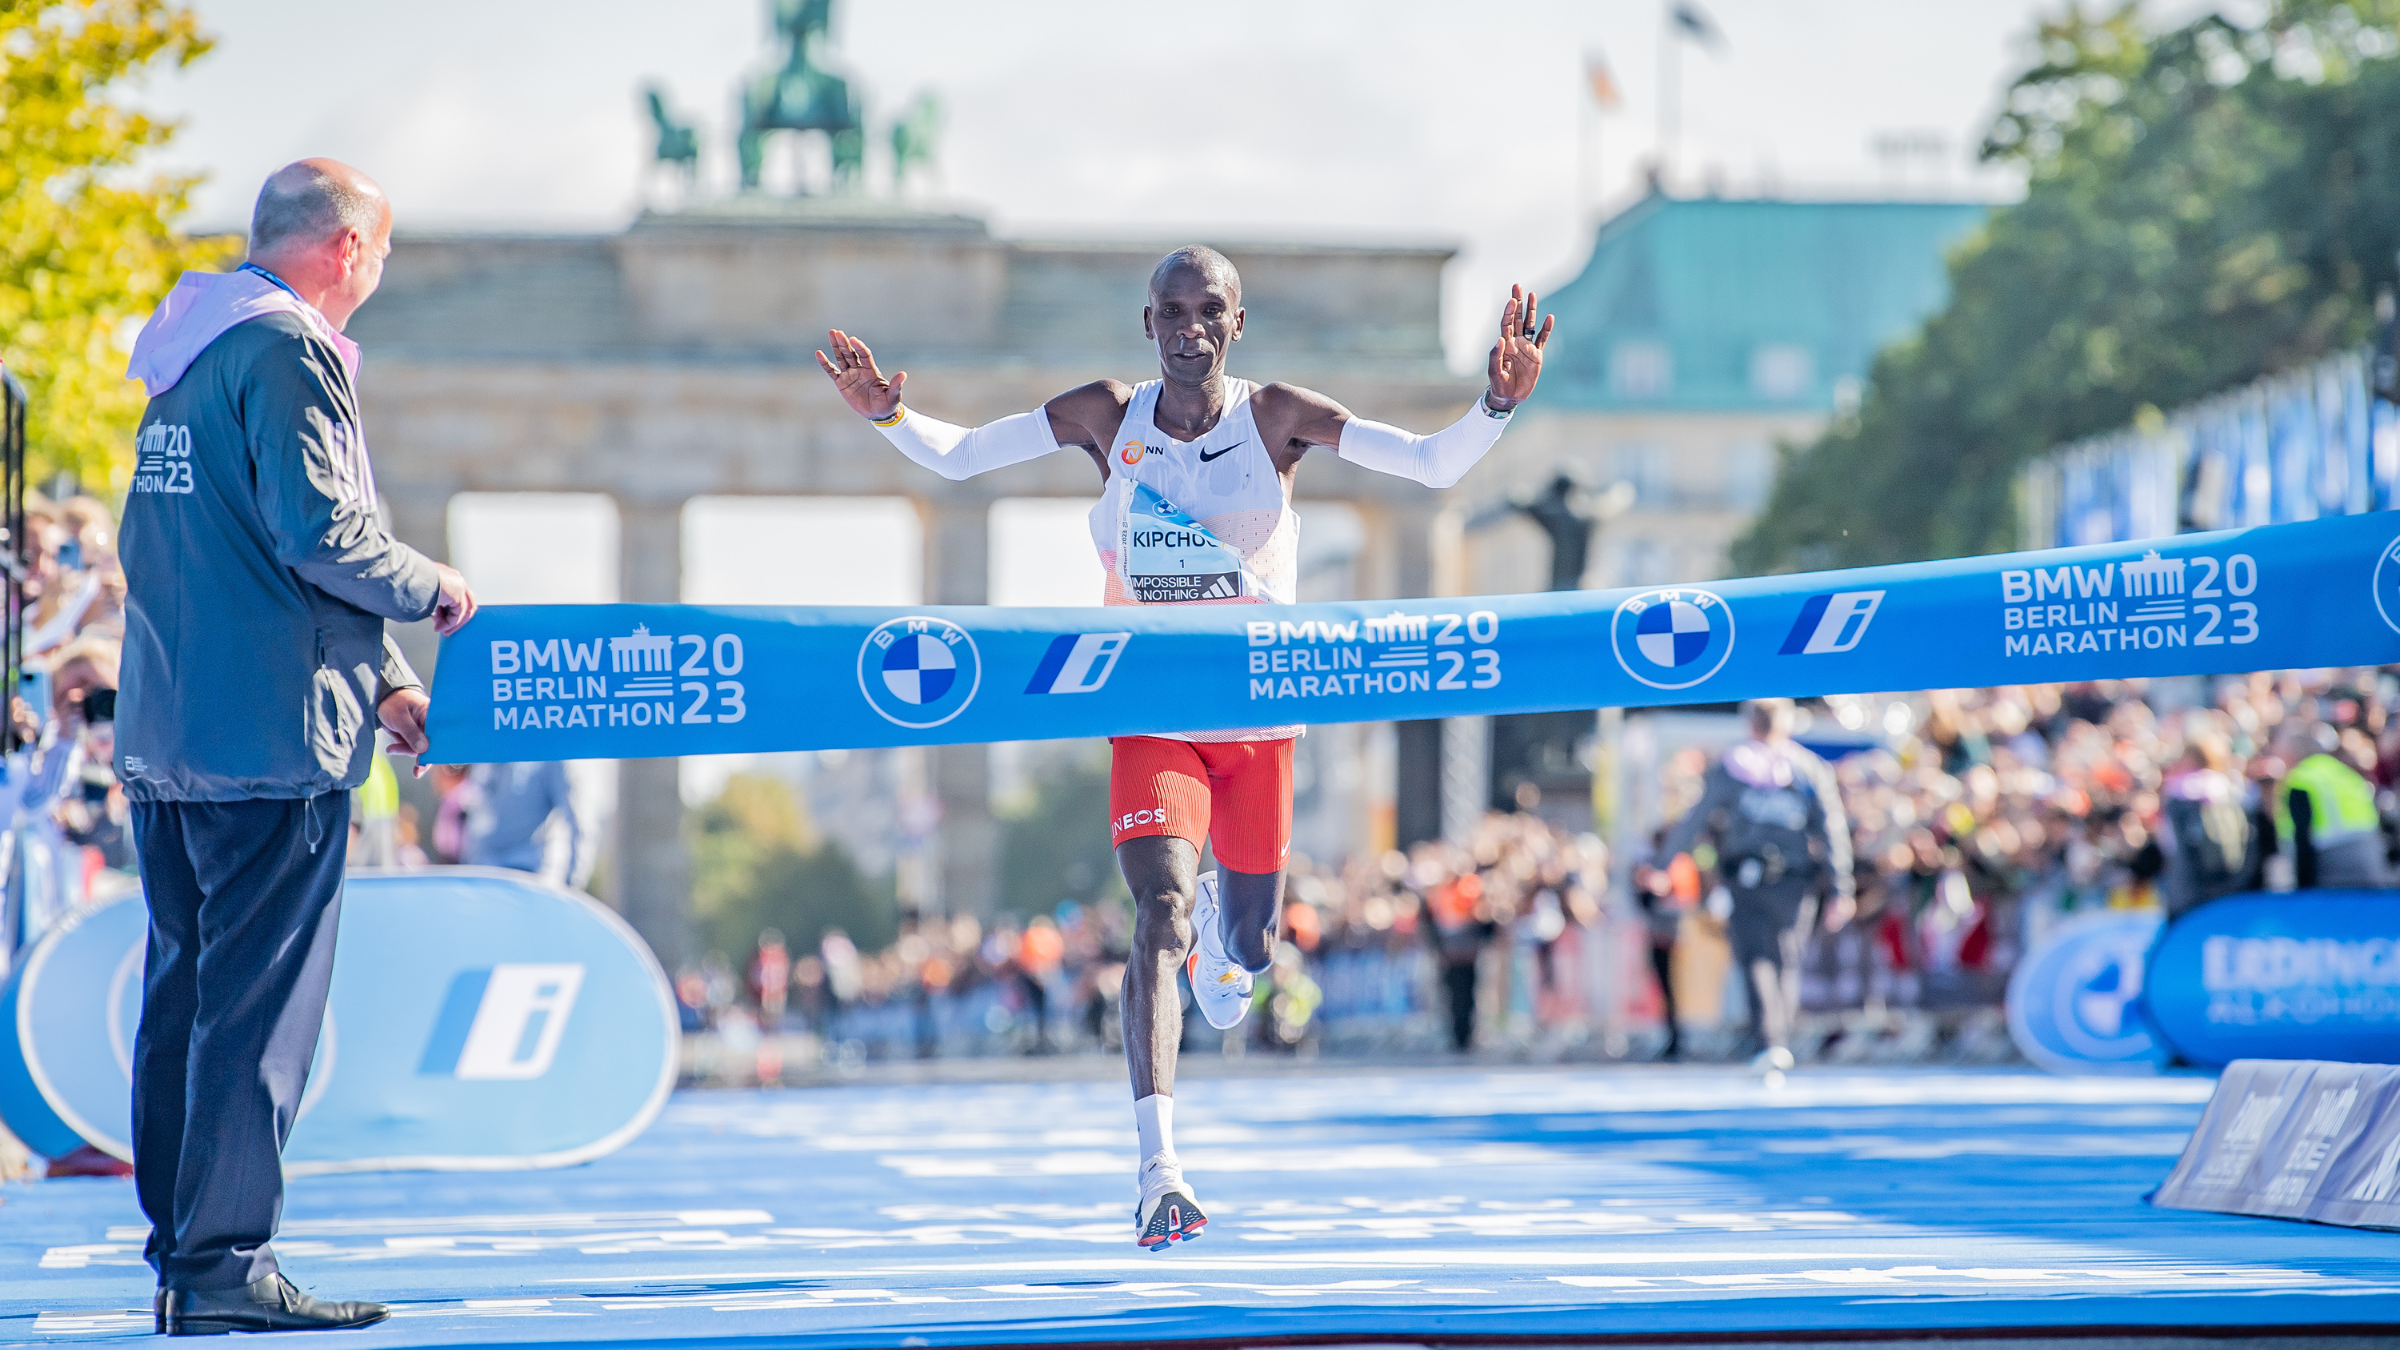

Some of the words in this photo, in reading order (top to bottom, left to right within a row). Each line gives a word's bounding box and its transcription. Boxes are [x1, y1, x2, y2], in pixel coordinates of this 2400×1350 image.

[165, 424, 191, 458] 20
[1145, 445, 1164, 456] NN
[129, 475, 163, 493] THON
[164, 460, 194, 494] 23
[1179, 558, 1185, 569] 1
[2190, 553, 2258, 600] 20
[1131, 576, 1202, 588] MPOSSIBLE
[1143, 588, 1199, 601] NOTHING
[2001, 562, 2115, 604] BMW
[1432, 610, 1499, 646] 20
[2004, 601, 2118, 630] BERLIN
[2193, 601, 2260, 646] 23
[1246, 619, 1359, 647] BMW
[2005, 624, 2187, 658] MARATHON
[490, 638, 603, 675] BMW
[678, 633, 744, 677] 20
[1248, 646, 1362, 674] BERLIN
[1435, 649, 1502, 691] 23
[492, 675, 607, 702] BERLIN
[1250, 669, 1430, 701] MARATHON
[493, 701, 675, 730] MARATHON
[680, 680, 747, 724] 23
[1111, 808, 1166, 839] INEOS
